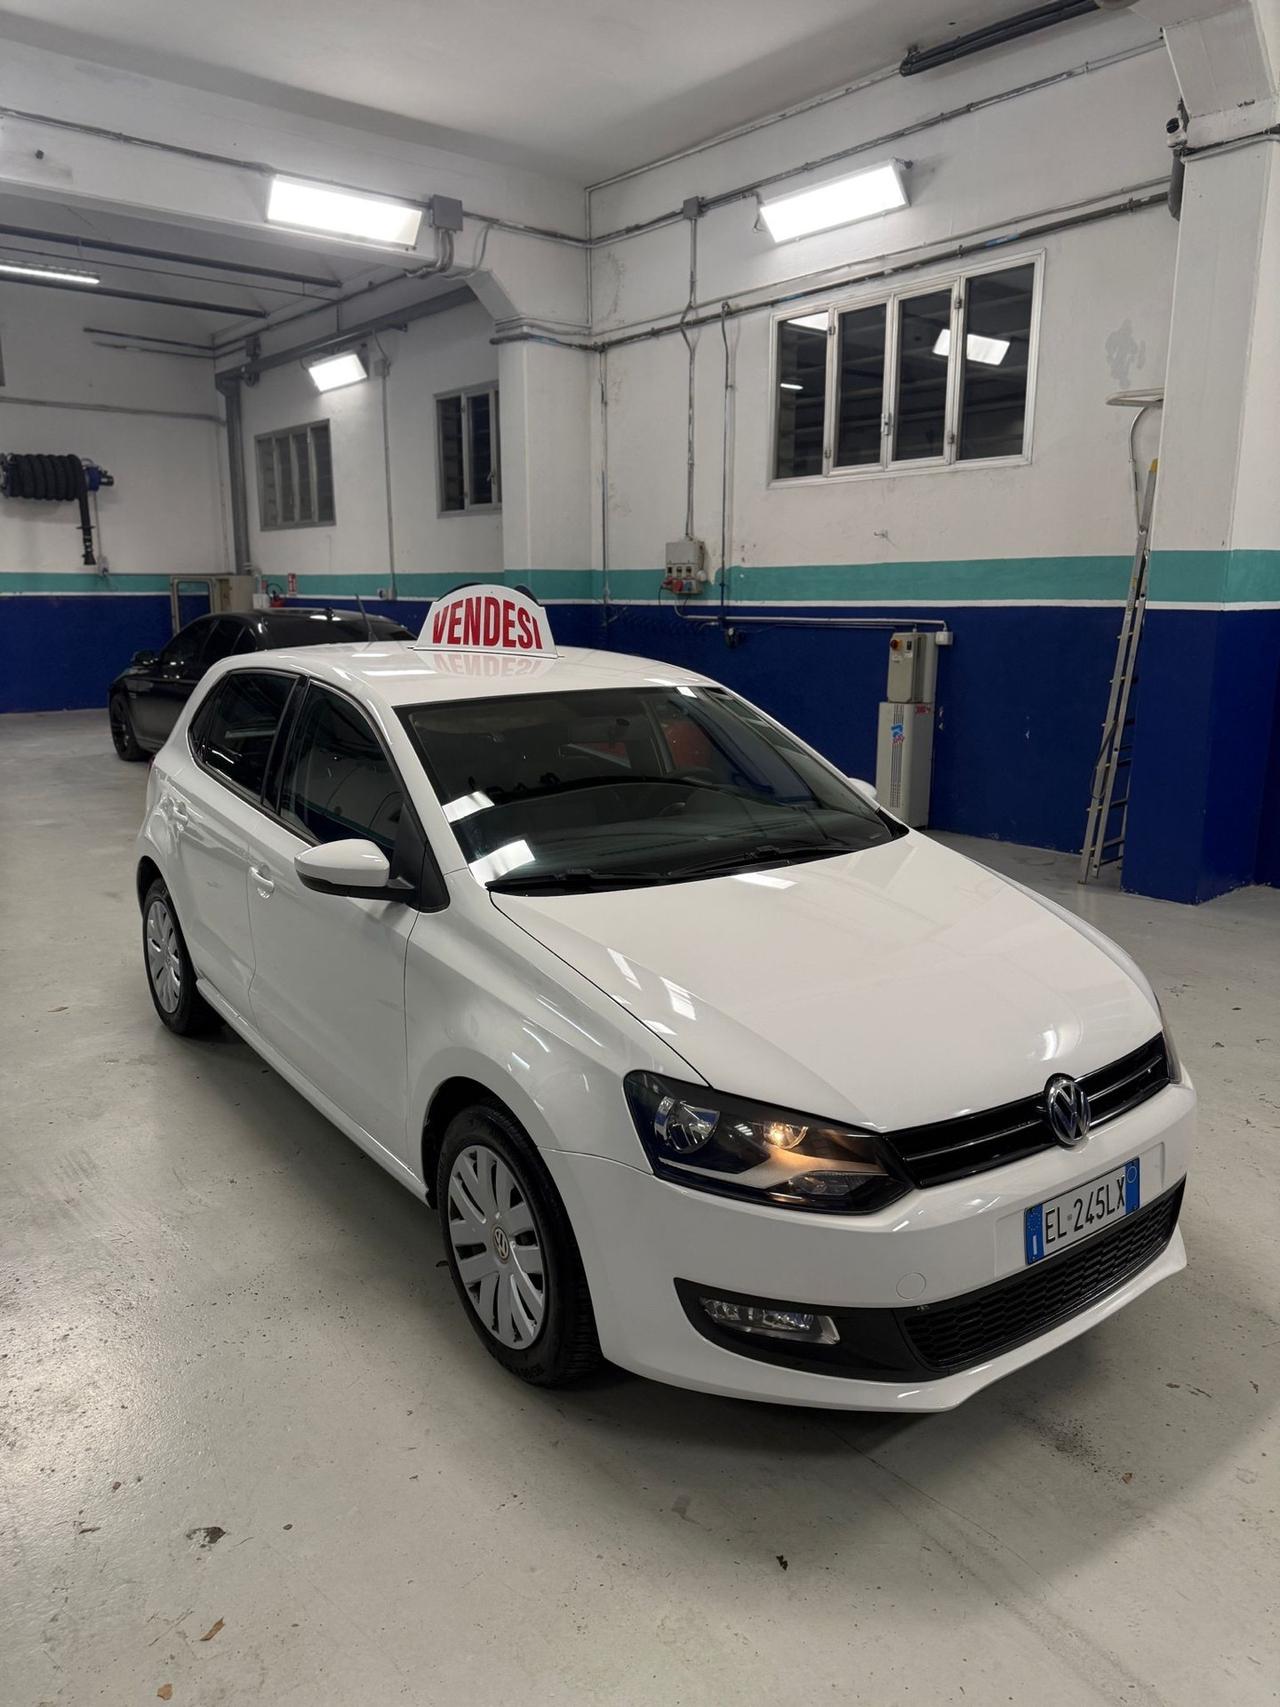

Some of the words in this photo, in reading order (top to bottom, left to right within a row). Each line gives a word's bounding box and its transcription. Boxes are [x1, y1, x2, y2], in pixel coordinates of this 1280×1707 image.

[432, 596, 543, 650] VENDESI
[1045, 1207, 1067, 1244] EL
[1073, 1176, 1125, 1232] 245LX
